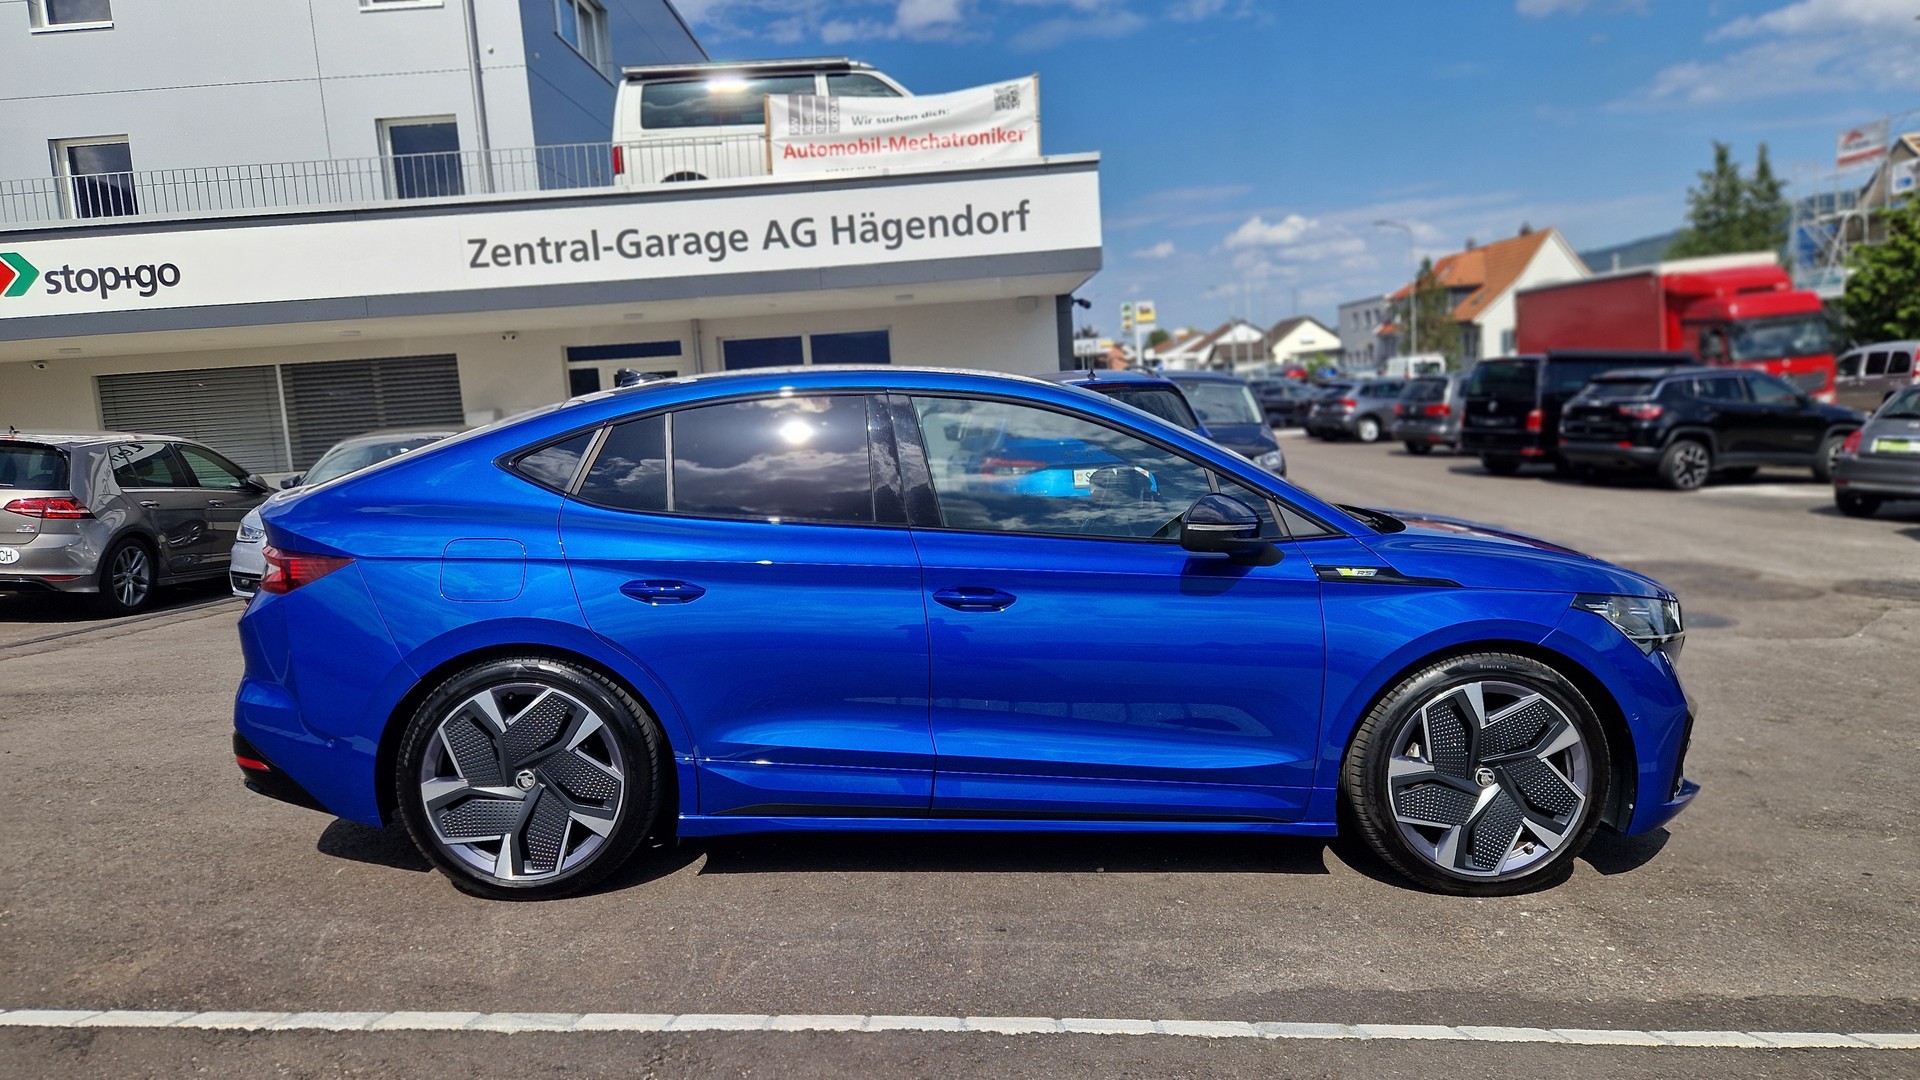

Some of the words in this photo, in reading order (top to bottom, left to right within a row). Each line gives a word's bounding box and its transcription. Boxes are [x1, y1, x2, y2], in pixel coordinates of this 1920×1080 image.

[851, 116, 873, 126] Wir
[876, 114, 918, 124] suchen
[783, 127, 1026, 159] Automobil-Mechatroniker
[467, 228, 749, 268] Zentral-Garage
[762, 217, 817, 250] AG
[831, 199, 1030, 250] Hägendorf
[44, 262, 181, 300] stop+go
[0, 550, 13, 562] CH
